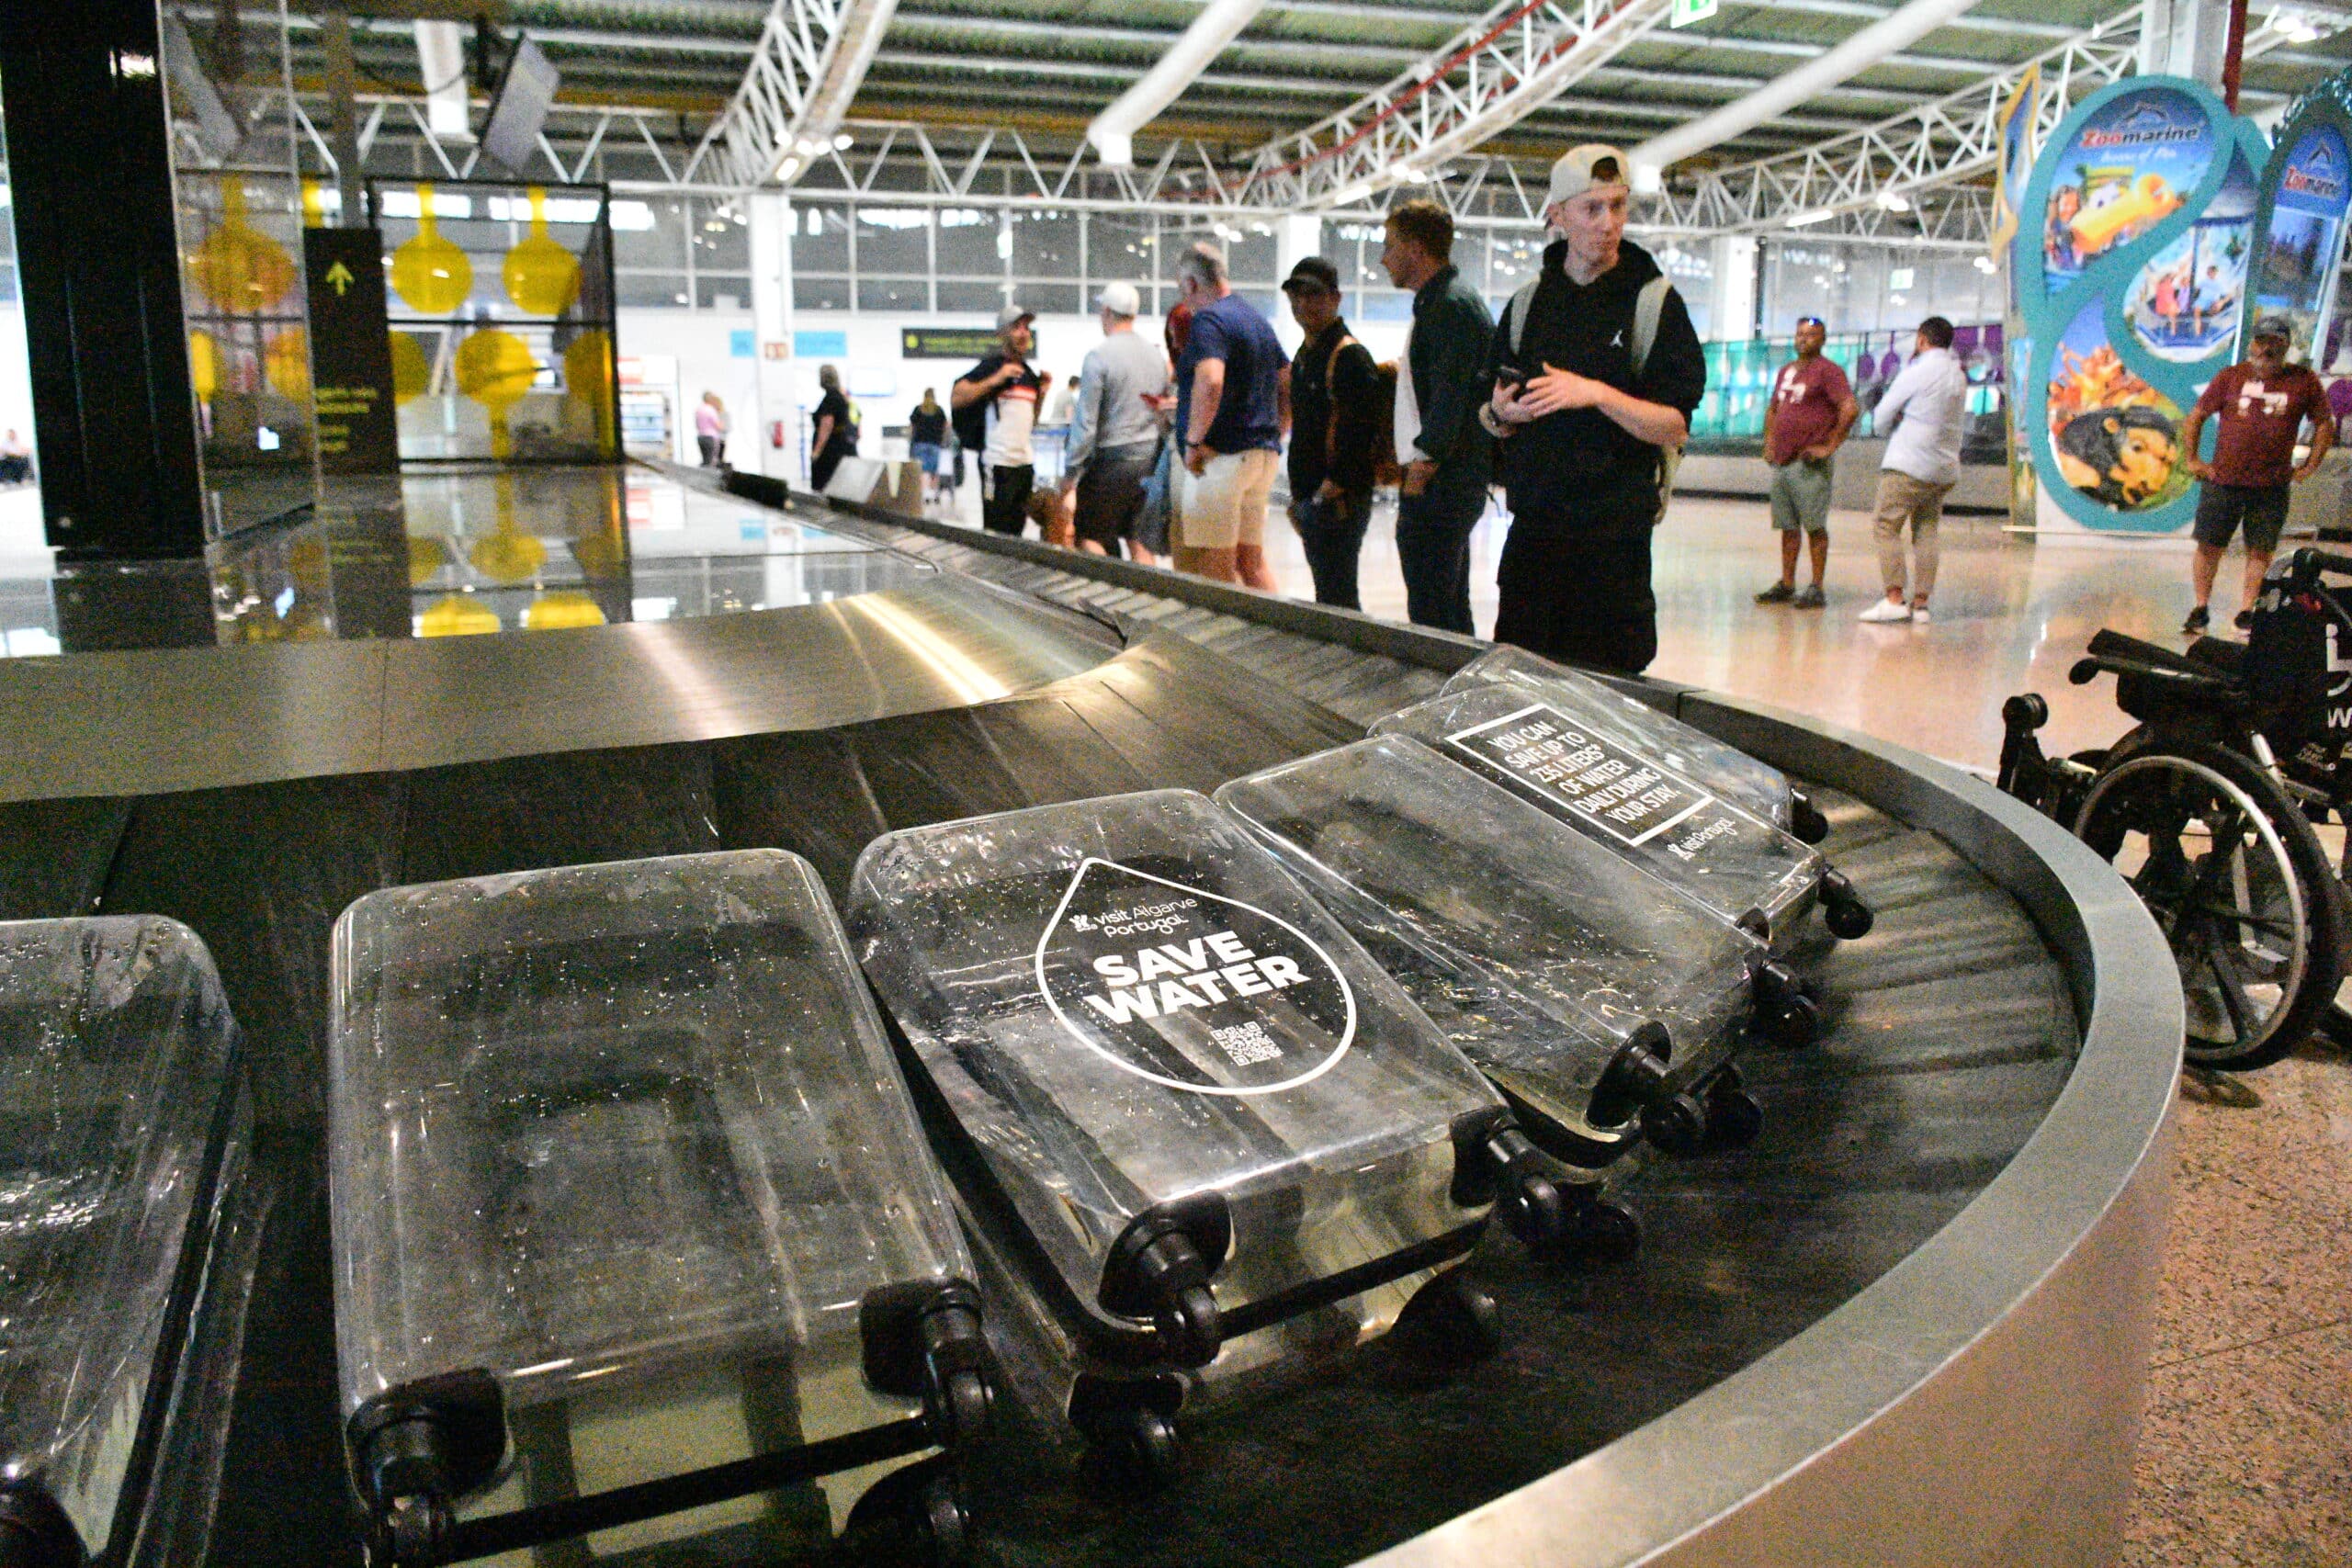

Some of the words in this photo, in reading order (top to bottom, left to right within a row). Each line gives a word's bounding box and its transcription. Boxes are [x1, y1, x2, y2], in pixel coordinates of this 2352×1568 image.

[2081, 126, 2199, 147] Zoomarine
[1487, 731, 1527, 751] YOU
[1520, 721, 1557, 741] CAN
[1504, 746, 1547, 769] SAVE
[1537, 739, 1566, 761] UP
[1556, 731, 1587, 748] TO
[1529, 764, 1564, 783] 235
[1558, 778, 1587, 795] OF
[1575, 759, 1632, 787] WATER
[1573, 788, 1619, 814] DAILY
[1606, 767, 1662, 799] DURING
[1604, 800, 1653, 824] YOUR
[1639, 784, 1682, 809] STAY.
[1092, 909, 1132, 925] visit
[1133, 898, 1198, 919] Algarve
[1093, 931, 1256, 987] SAVE
[1082, 955, 1312, 1024] WATER
